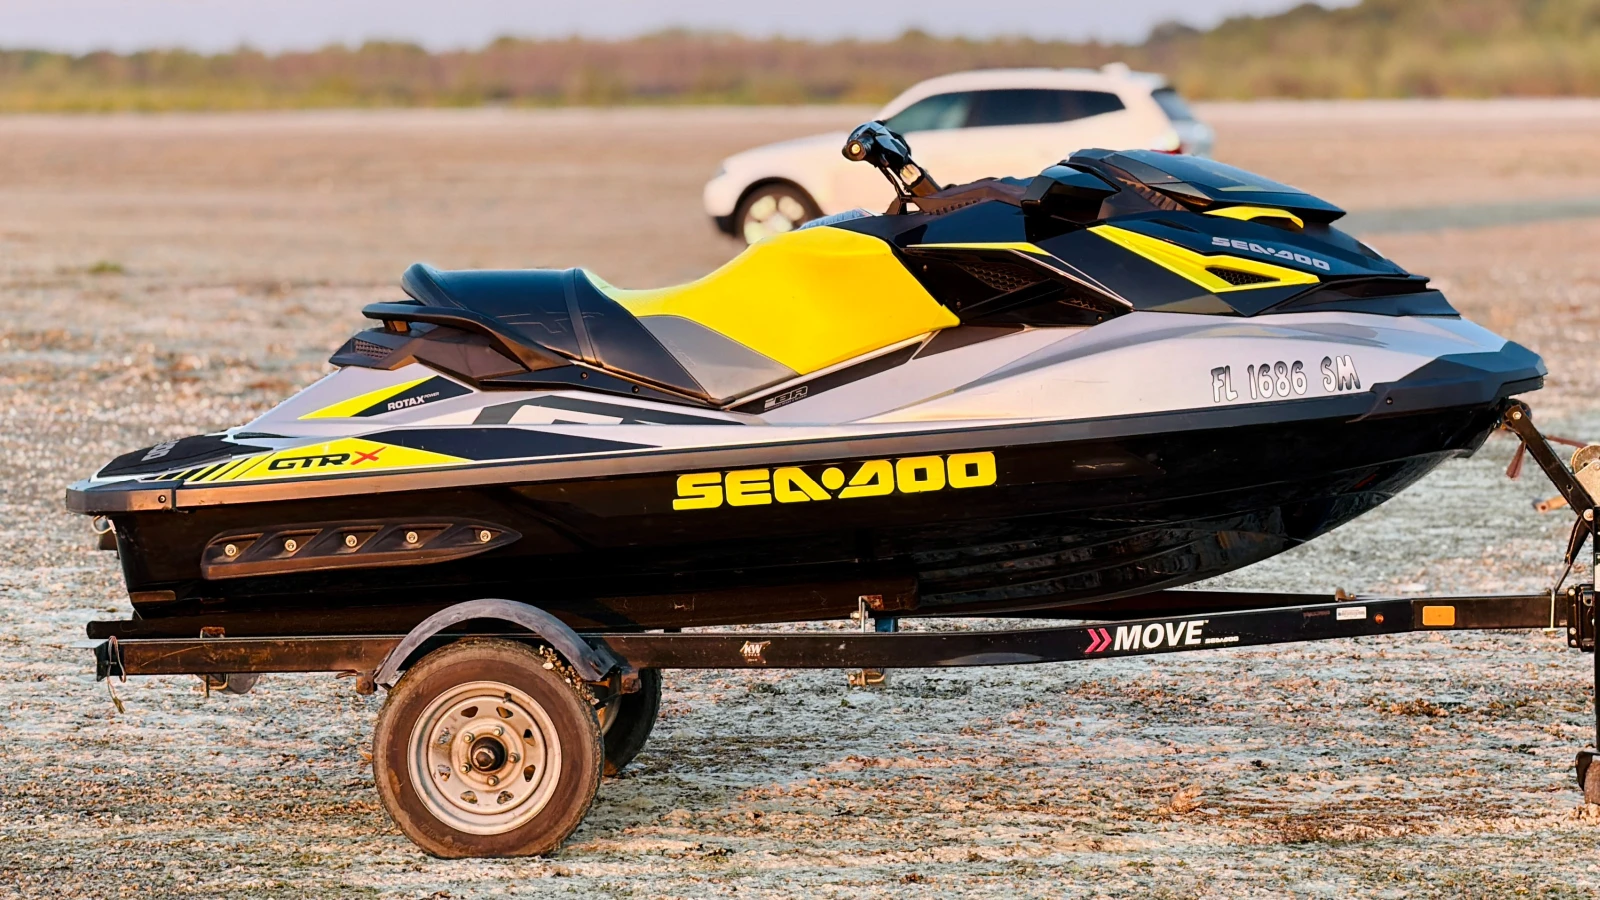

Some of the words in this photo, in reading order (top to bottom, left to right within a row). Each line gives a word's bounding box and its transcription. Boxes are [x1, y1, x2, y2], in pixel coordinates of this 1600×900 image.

[1210, 364, 1239, 403] FL
[1246, 360, 1308, 400] 1686
[1320, 355, 1362, 393] SM
[387, 395, 425, 411] ROTAX
[1113, 619, 1205, 651] MOVE
